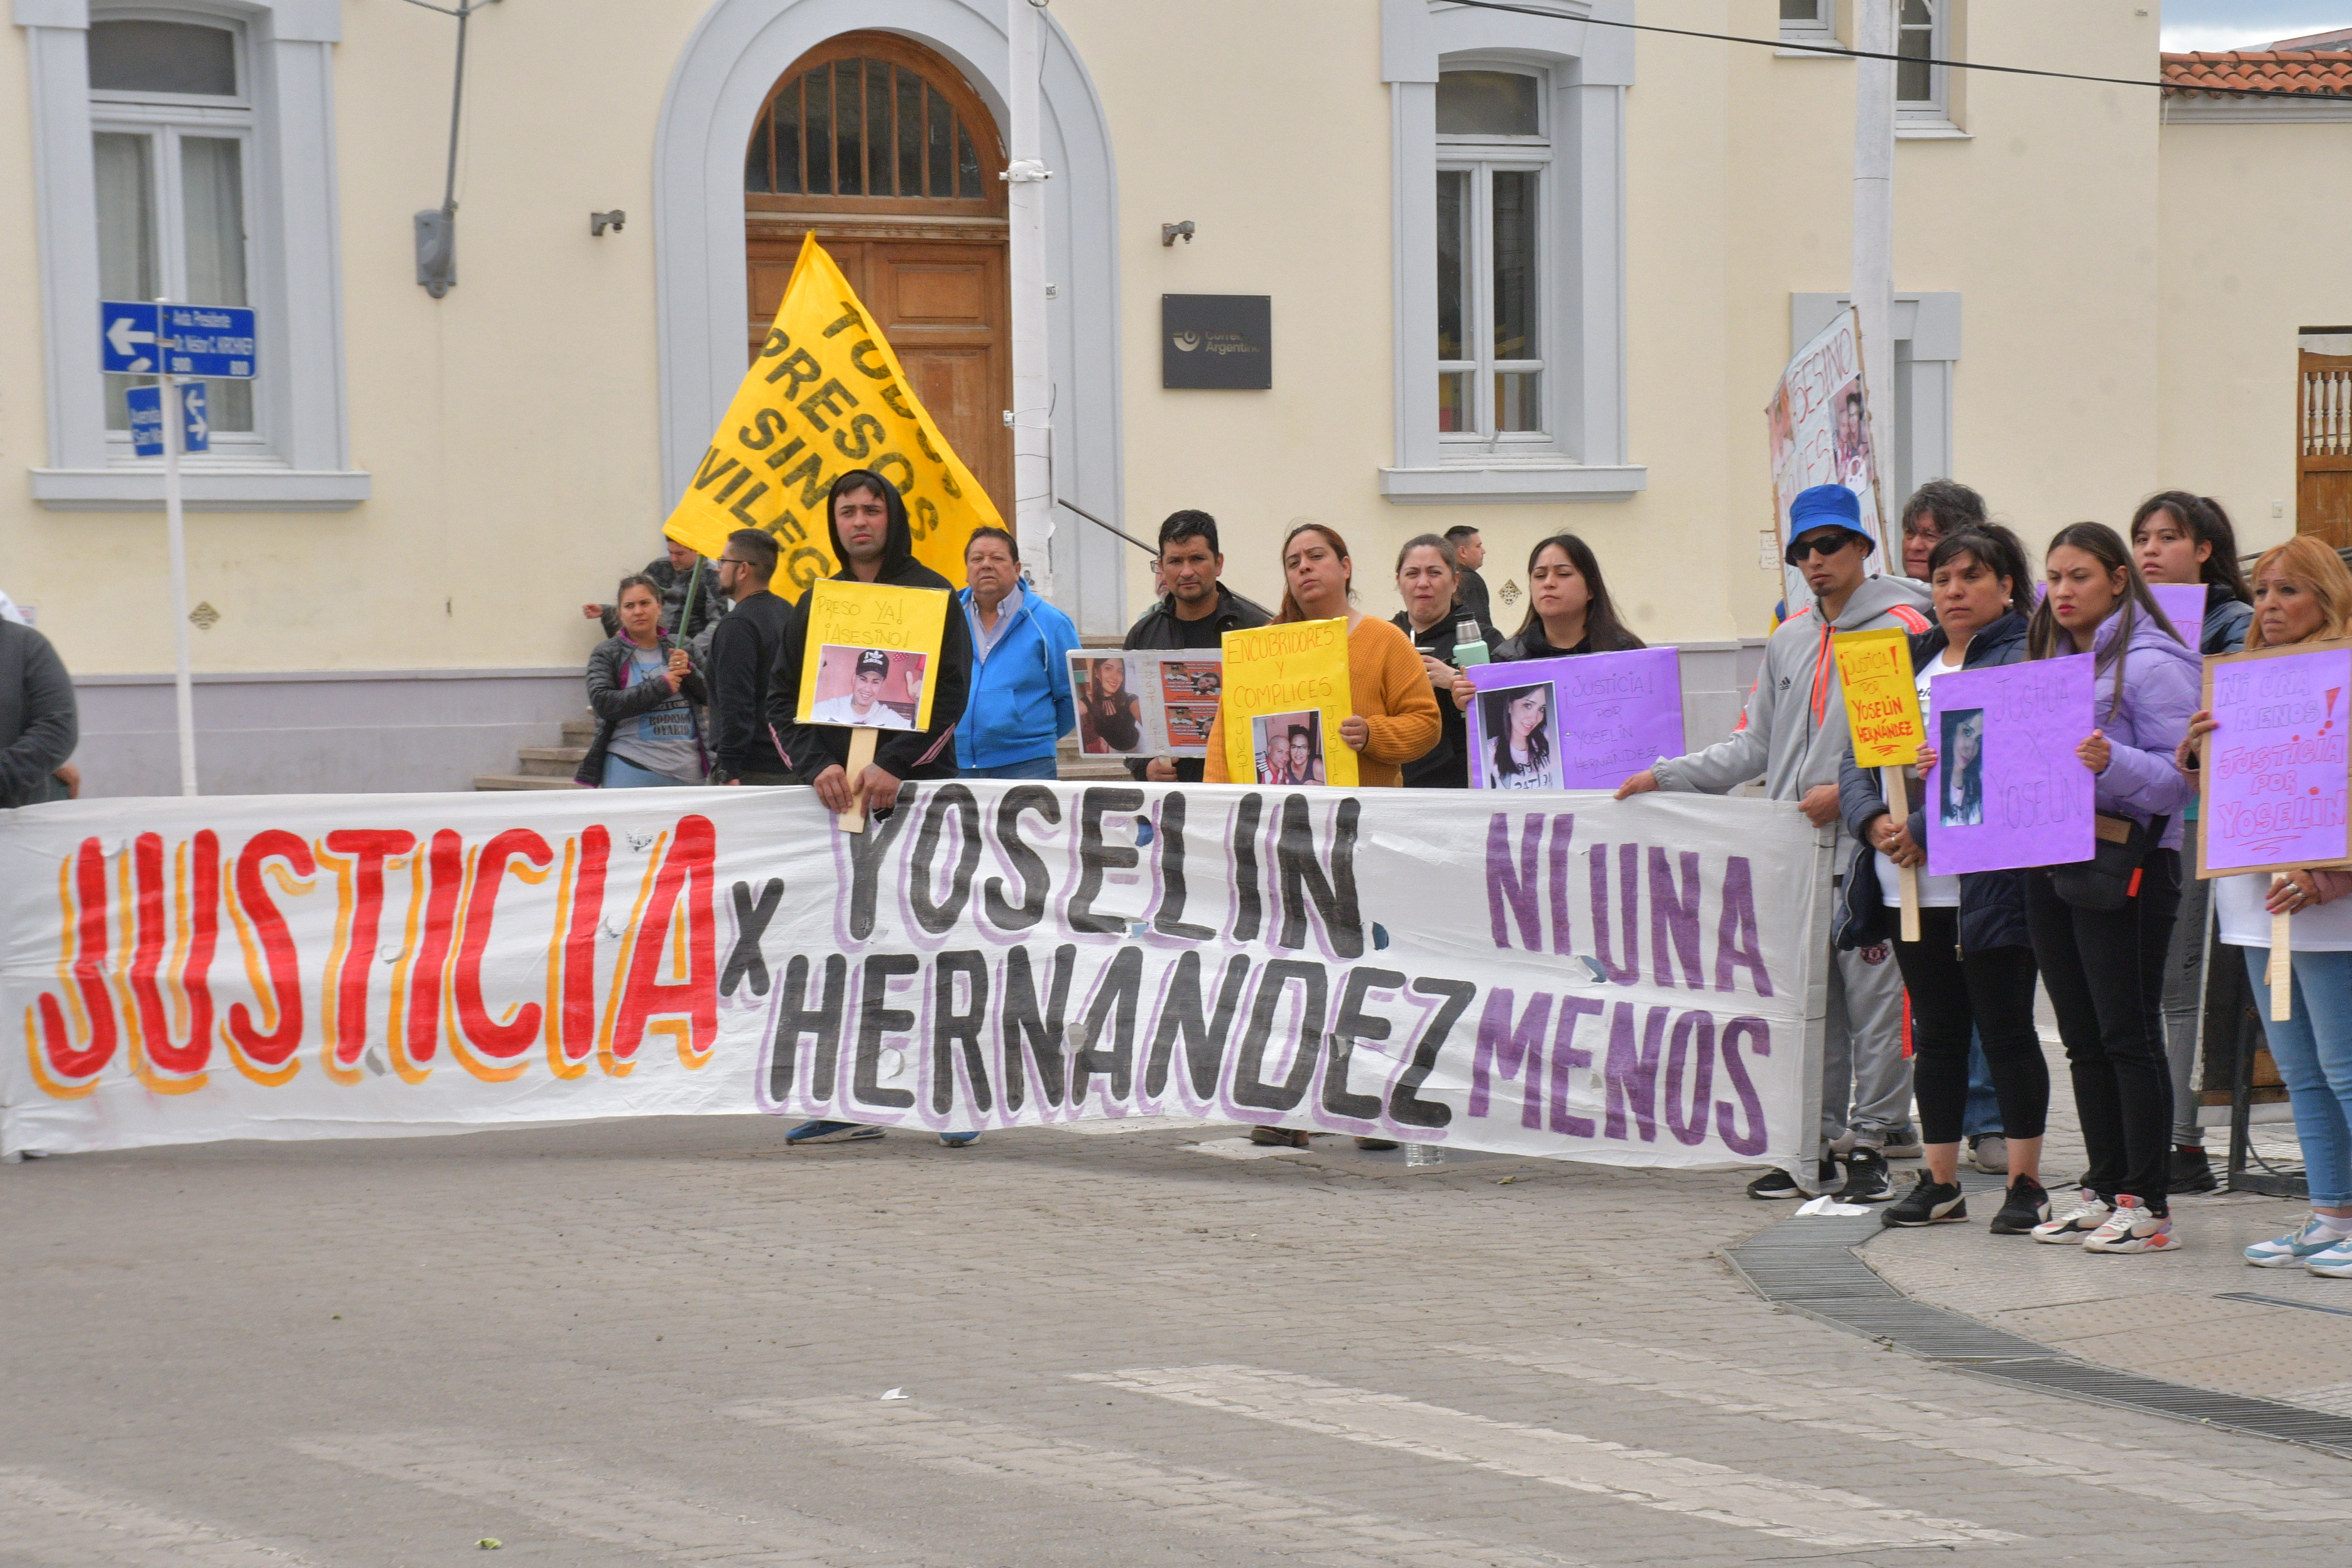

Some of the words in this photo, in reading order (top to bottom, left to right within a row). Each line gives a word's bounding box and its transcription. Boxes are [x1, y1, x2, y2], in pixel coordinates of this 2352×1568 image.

[738, 408, 840, 511] SIN
[760, 328, 939, 542] PRESOS
[694, 444, 831, 590] VILEG
[816, 596, 861, 619] PRESO
[874, 598, 903, 625] YA!
[1227, 626, 1335, 664] ENCUBRIDORES
[1275, 661, 1284, 679] Y
[1233, 676, 1333, 709] COMPLICES
[1851, 695, 1904, 723] YOSELIN
[2218, 672, 2251, 707] NI
[1236, 716, 1249, 784] JUSTI
[1325, 705, 1340, 785] JUSTIC
[1574, 724, 1633, 750] YOSELIN
[1989, 763, 2082, 830] YOSELIN
[2217, 786, 2347, 839] YOSELIN
[2251, 770, 2297, 796] POR
[848, 782, 1364, 959] YOSELIN
[1486, 812, 1575, 956] NI
[1589, 843, 1774, 997] UNA
[25, 814, 718, 1099] JUSTICIA
[770, 943, 1477, 1128] HERNANDEZ
[1467, 987, 1771, 1156] MENOS
